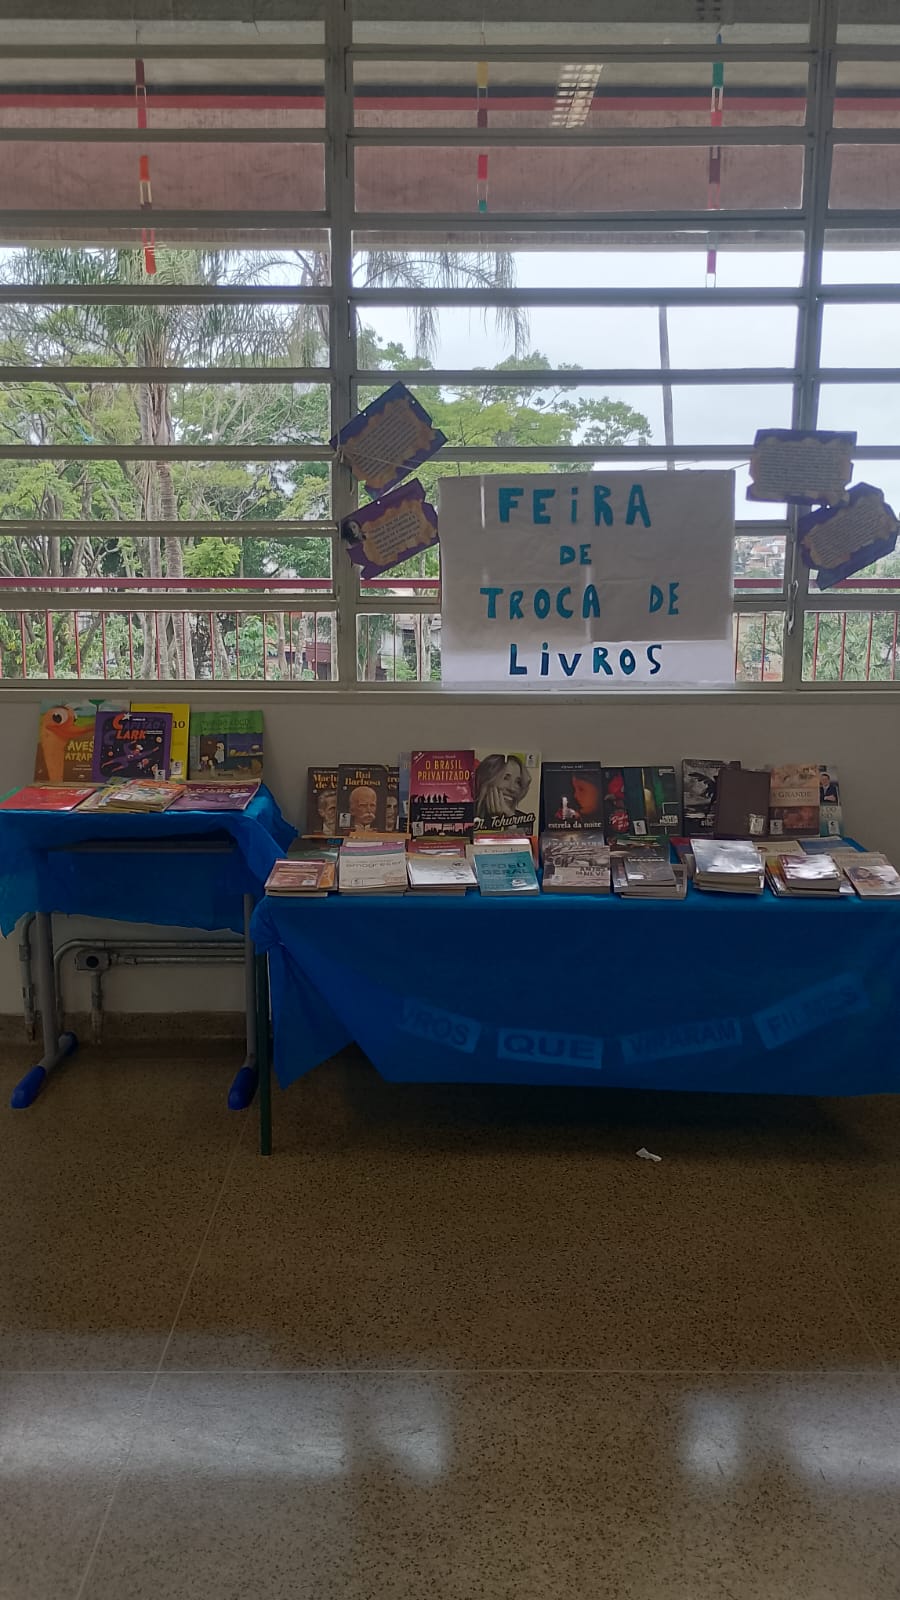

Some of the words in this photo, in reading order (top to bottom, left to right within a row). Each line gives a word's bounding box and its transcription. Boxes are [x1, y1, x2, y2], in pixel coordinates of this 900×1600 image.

[559, 543, 592, 566] DE
[480, 584, 600, 620] TROCA
[649, 582, 679, 616] DE
[425, 760, 431, 770] O
[434, 759, 463, 770] BRASIL
[355, 771, 371, 779] Rui
[417, 770, 470, 781] PRIVATIZADO
[345, 777, 381, 786] Barbosa
[548, 820, 571, 828] estrela
[504, 1033, 595, 1060] QUE
